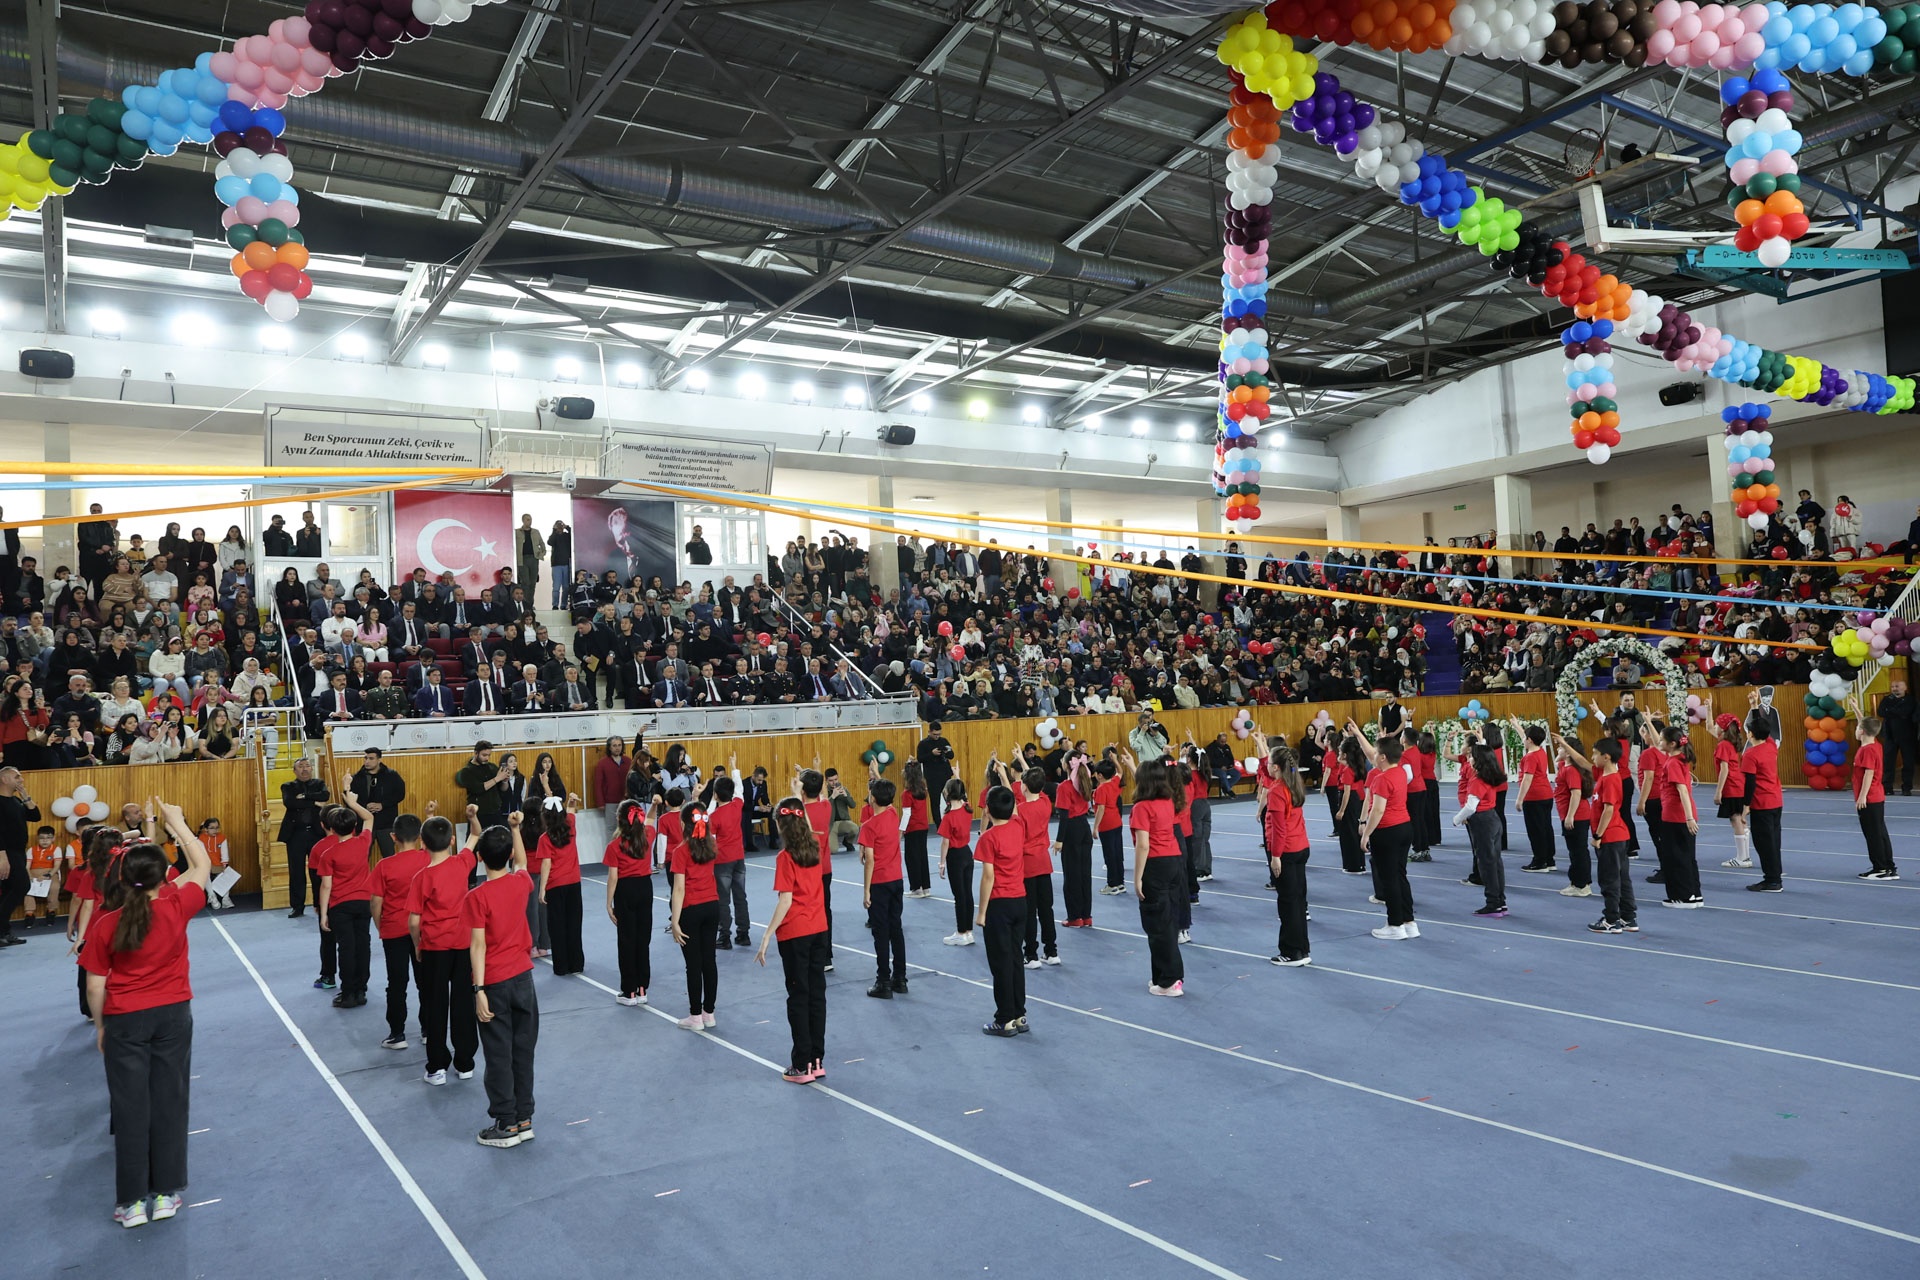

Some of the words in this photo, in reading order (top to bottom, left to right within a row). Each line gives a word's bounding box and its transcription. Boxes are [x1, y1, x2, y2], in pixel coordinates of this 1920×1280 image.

[304, 433, 325, 442] Ben
[326, 434, 385, 445] Sporcunun
[387, 438, 412, 447] Zeki,
[414, 439, 442, 449] Çevik
[444, 441, 455, 449] ve
[281, 445, 307, 456] Aynı
[309, 447, 363, 458] Zamanda
[365, 449, 423, 460] Ahlaklısını
[424, 452, 473, 462] Severim...
